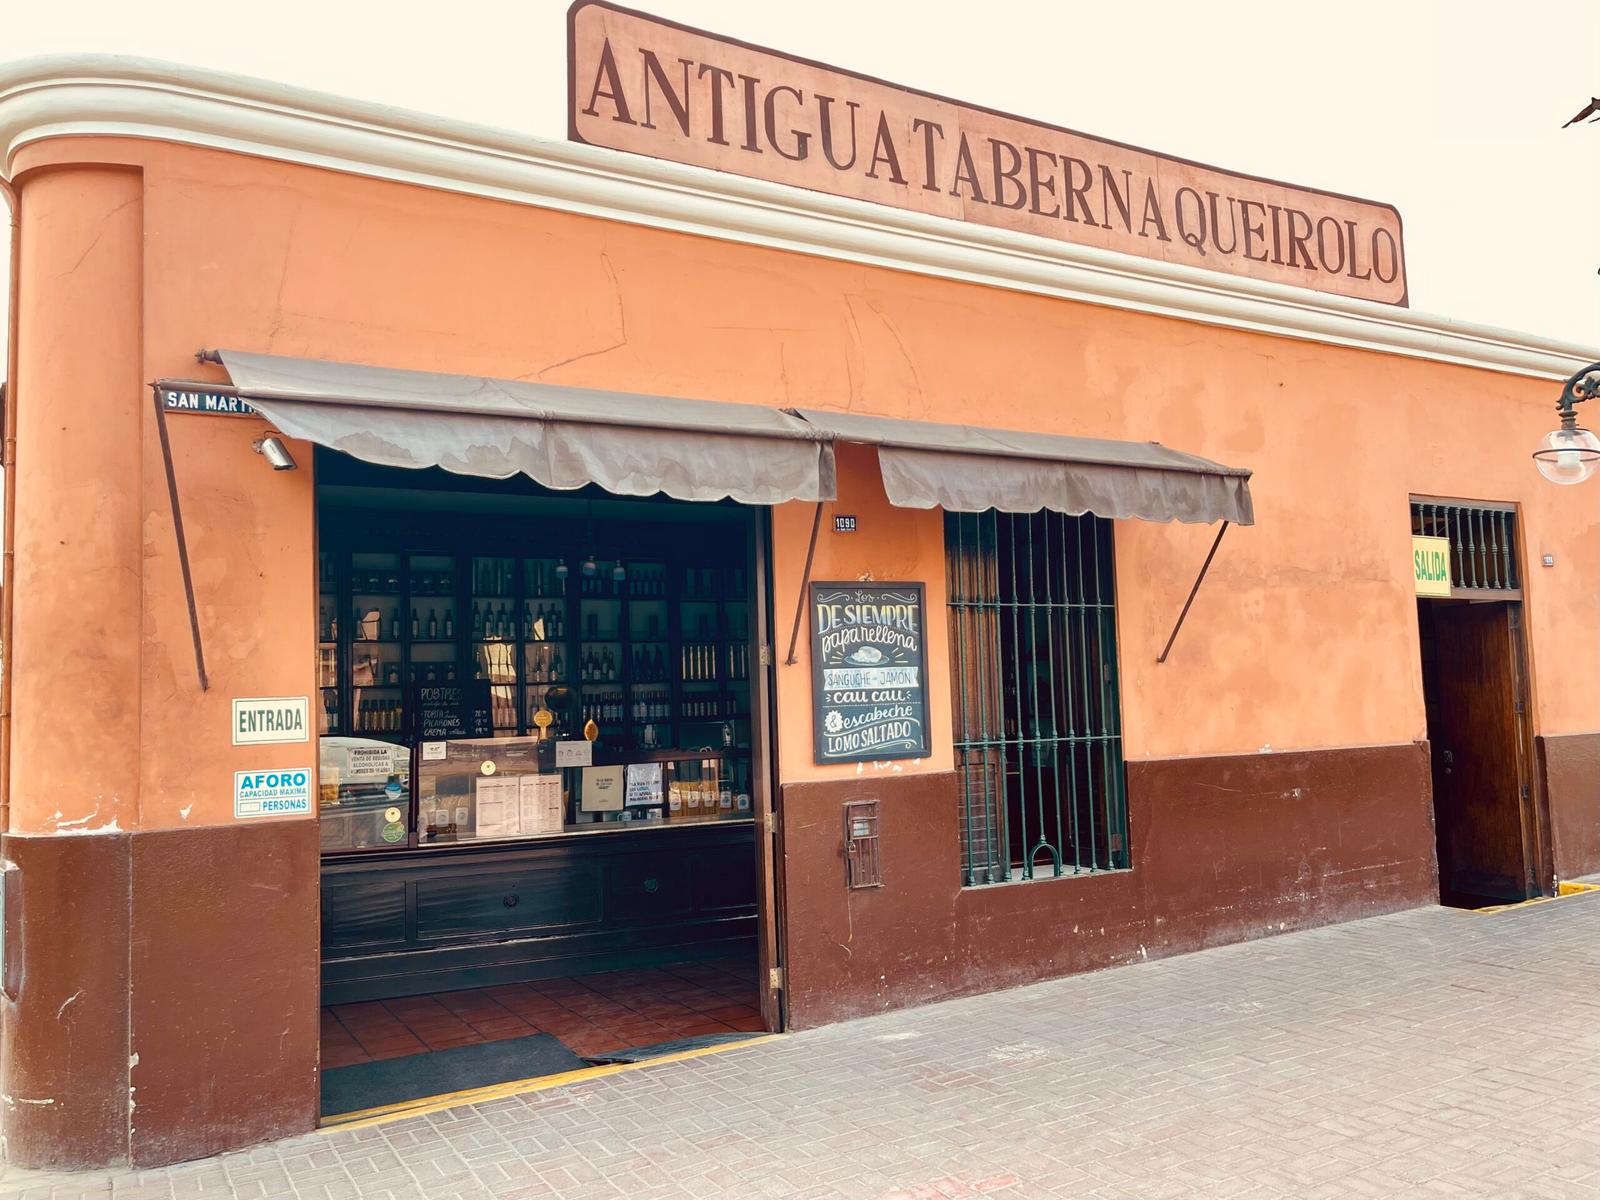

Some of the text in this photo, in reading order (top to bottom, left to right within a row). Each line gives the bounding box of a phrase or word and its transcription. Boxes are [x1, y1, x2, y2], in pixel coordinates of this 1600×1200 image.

[581, 37, 1398, 285] ANTIGUA TABERNA QUEIROLO
[168, 391, 199, 409] SAN
[836, 517, 855, 528] 1090
[1415, 549, 1447, 581] SALIDA
[855, 590, 875, 604] Los
[816, 604, 919, 635] DE SIEMPRE
[821, 625, 917, 663] papa rellena
[828, 672, 870, 687] SANGUCHE
[880, 671, 911, 685] JAMON
[833, 690, 906, 704] cau cau
[239, 708, 302, 733] ENTRADA
[843, 705, 912, 729] escabeche
[828, 721, 911, 752] LOMO SALTADO
[241, 773, 306, 789] AFORO
[240, 787, 306, 798] CAPACIDAD MAXIMA
[262, 799, 306, 811] PERSONAS
